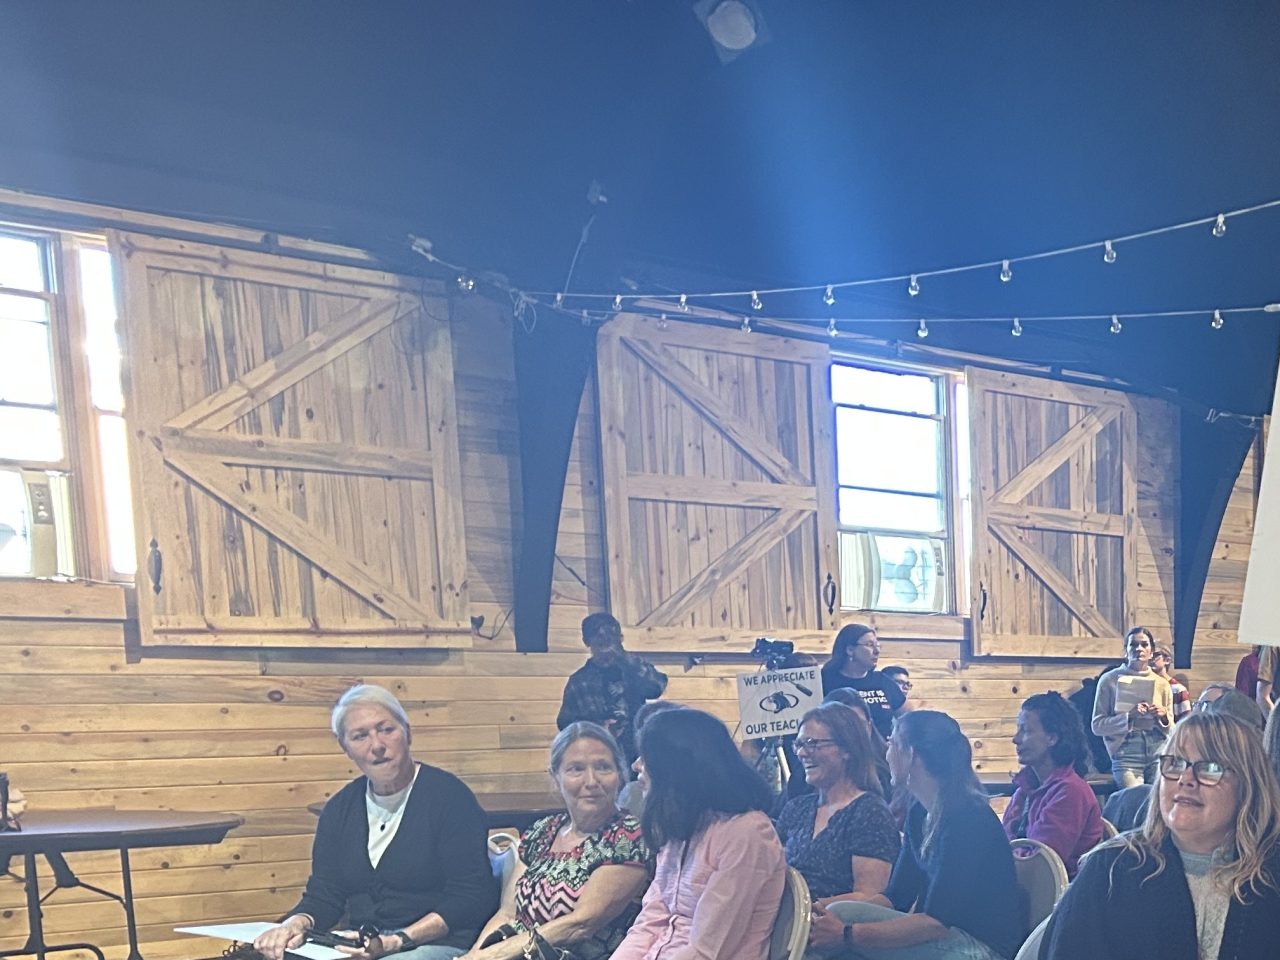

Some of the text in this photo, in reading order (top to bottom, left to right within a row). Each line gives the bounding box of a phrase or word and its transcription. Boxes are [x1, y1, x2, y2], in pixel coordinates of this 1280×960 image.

[743, 670, 816, 687] WE APPRECIATE
[745, 722, 768, 735] OUR
